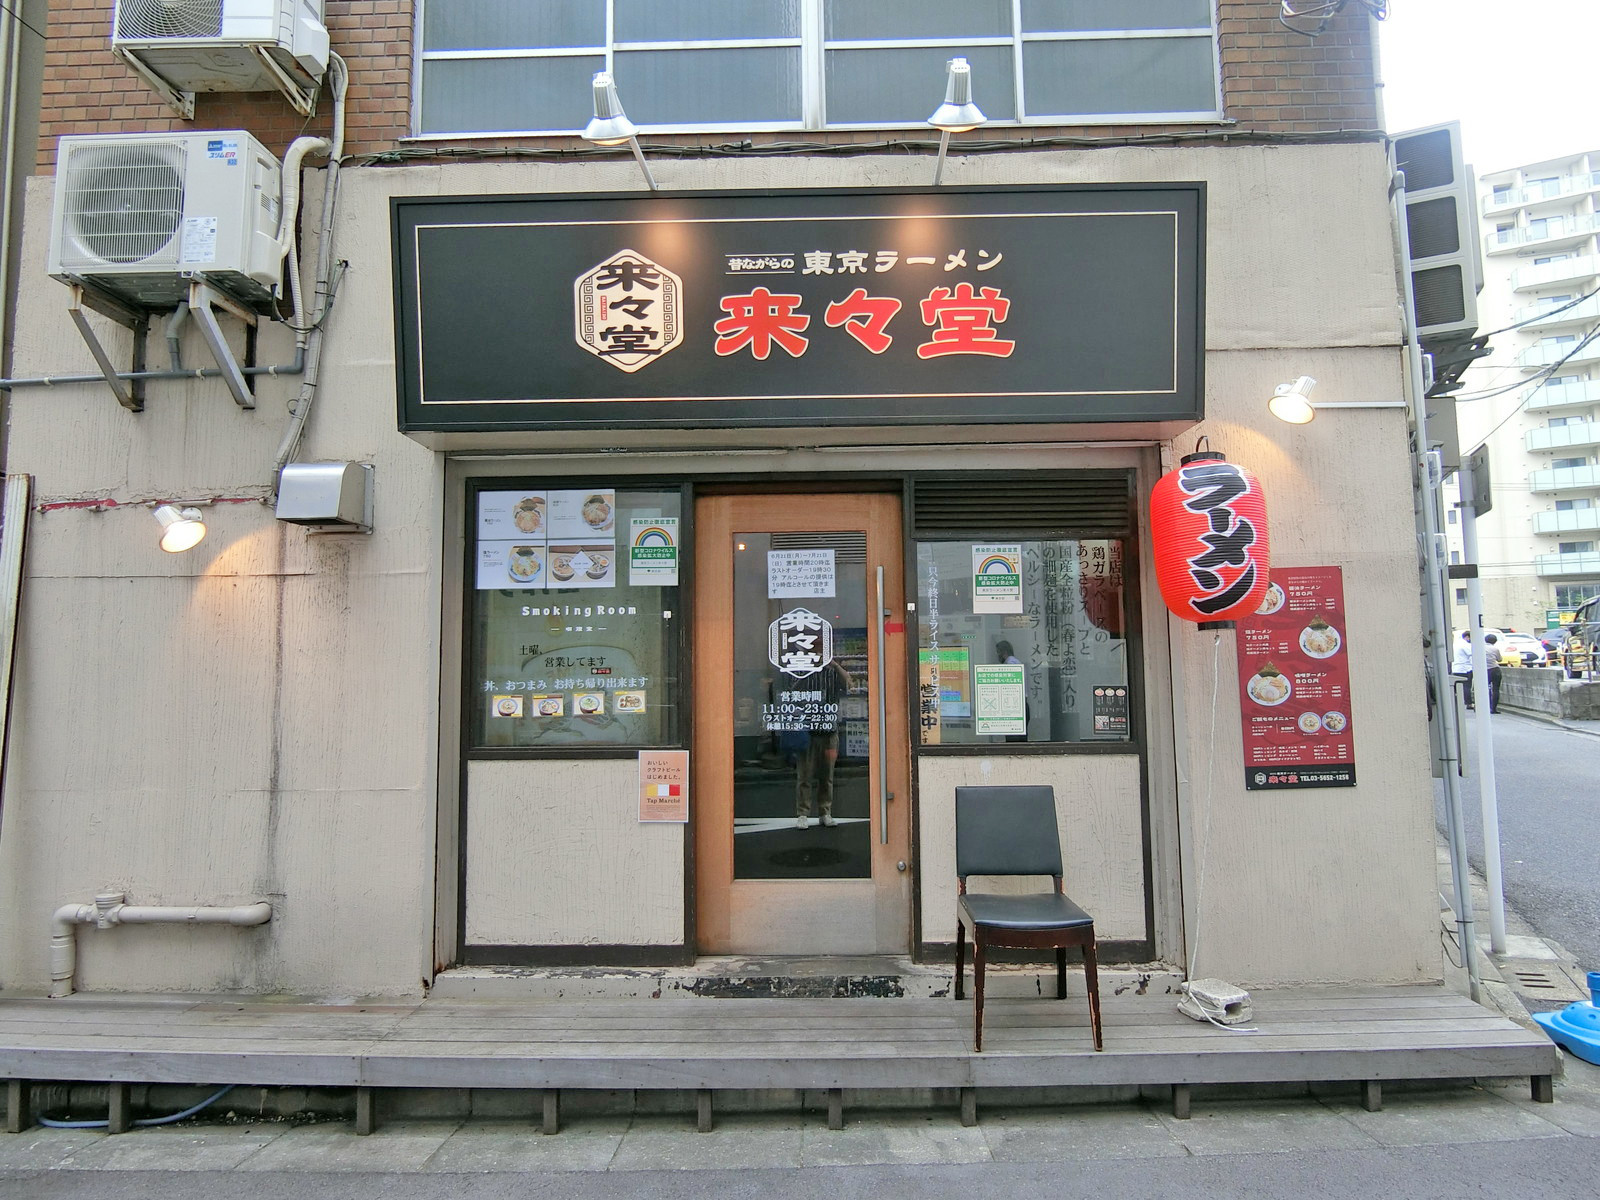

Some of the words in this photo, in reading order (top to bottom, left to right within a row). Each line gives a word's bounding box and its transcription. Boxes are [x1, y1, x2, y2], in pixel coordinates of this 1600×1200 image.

[728, 257, 795, 271] 昔ながらの
[801, 249, 1003, 275] 東京ラーメン
[597, 261, 663, 357] 来々堂
[714, 282, 1016, 361] 来々堂
[1177, 462, 1257, 615] ラーメン
[1108, 546, 1124, 587] 当店は
[521, 605, 592, 618] Smoking
[597, 605, 637, 616] Room
[779, 611, 823, 673] 来々堂
[544, 655, 607, 668] 営業してます
[554, 676, 648, 690] お持ち帰り出来ます
[780, 690, 822, 702] 営業時間
[762, 703, 838, 714] 11:00～23:00
